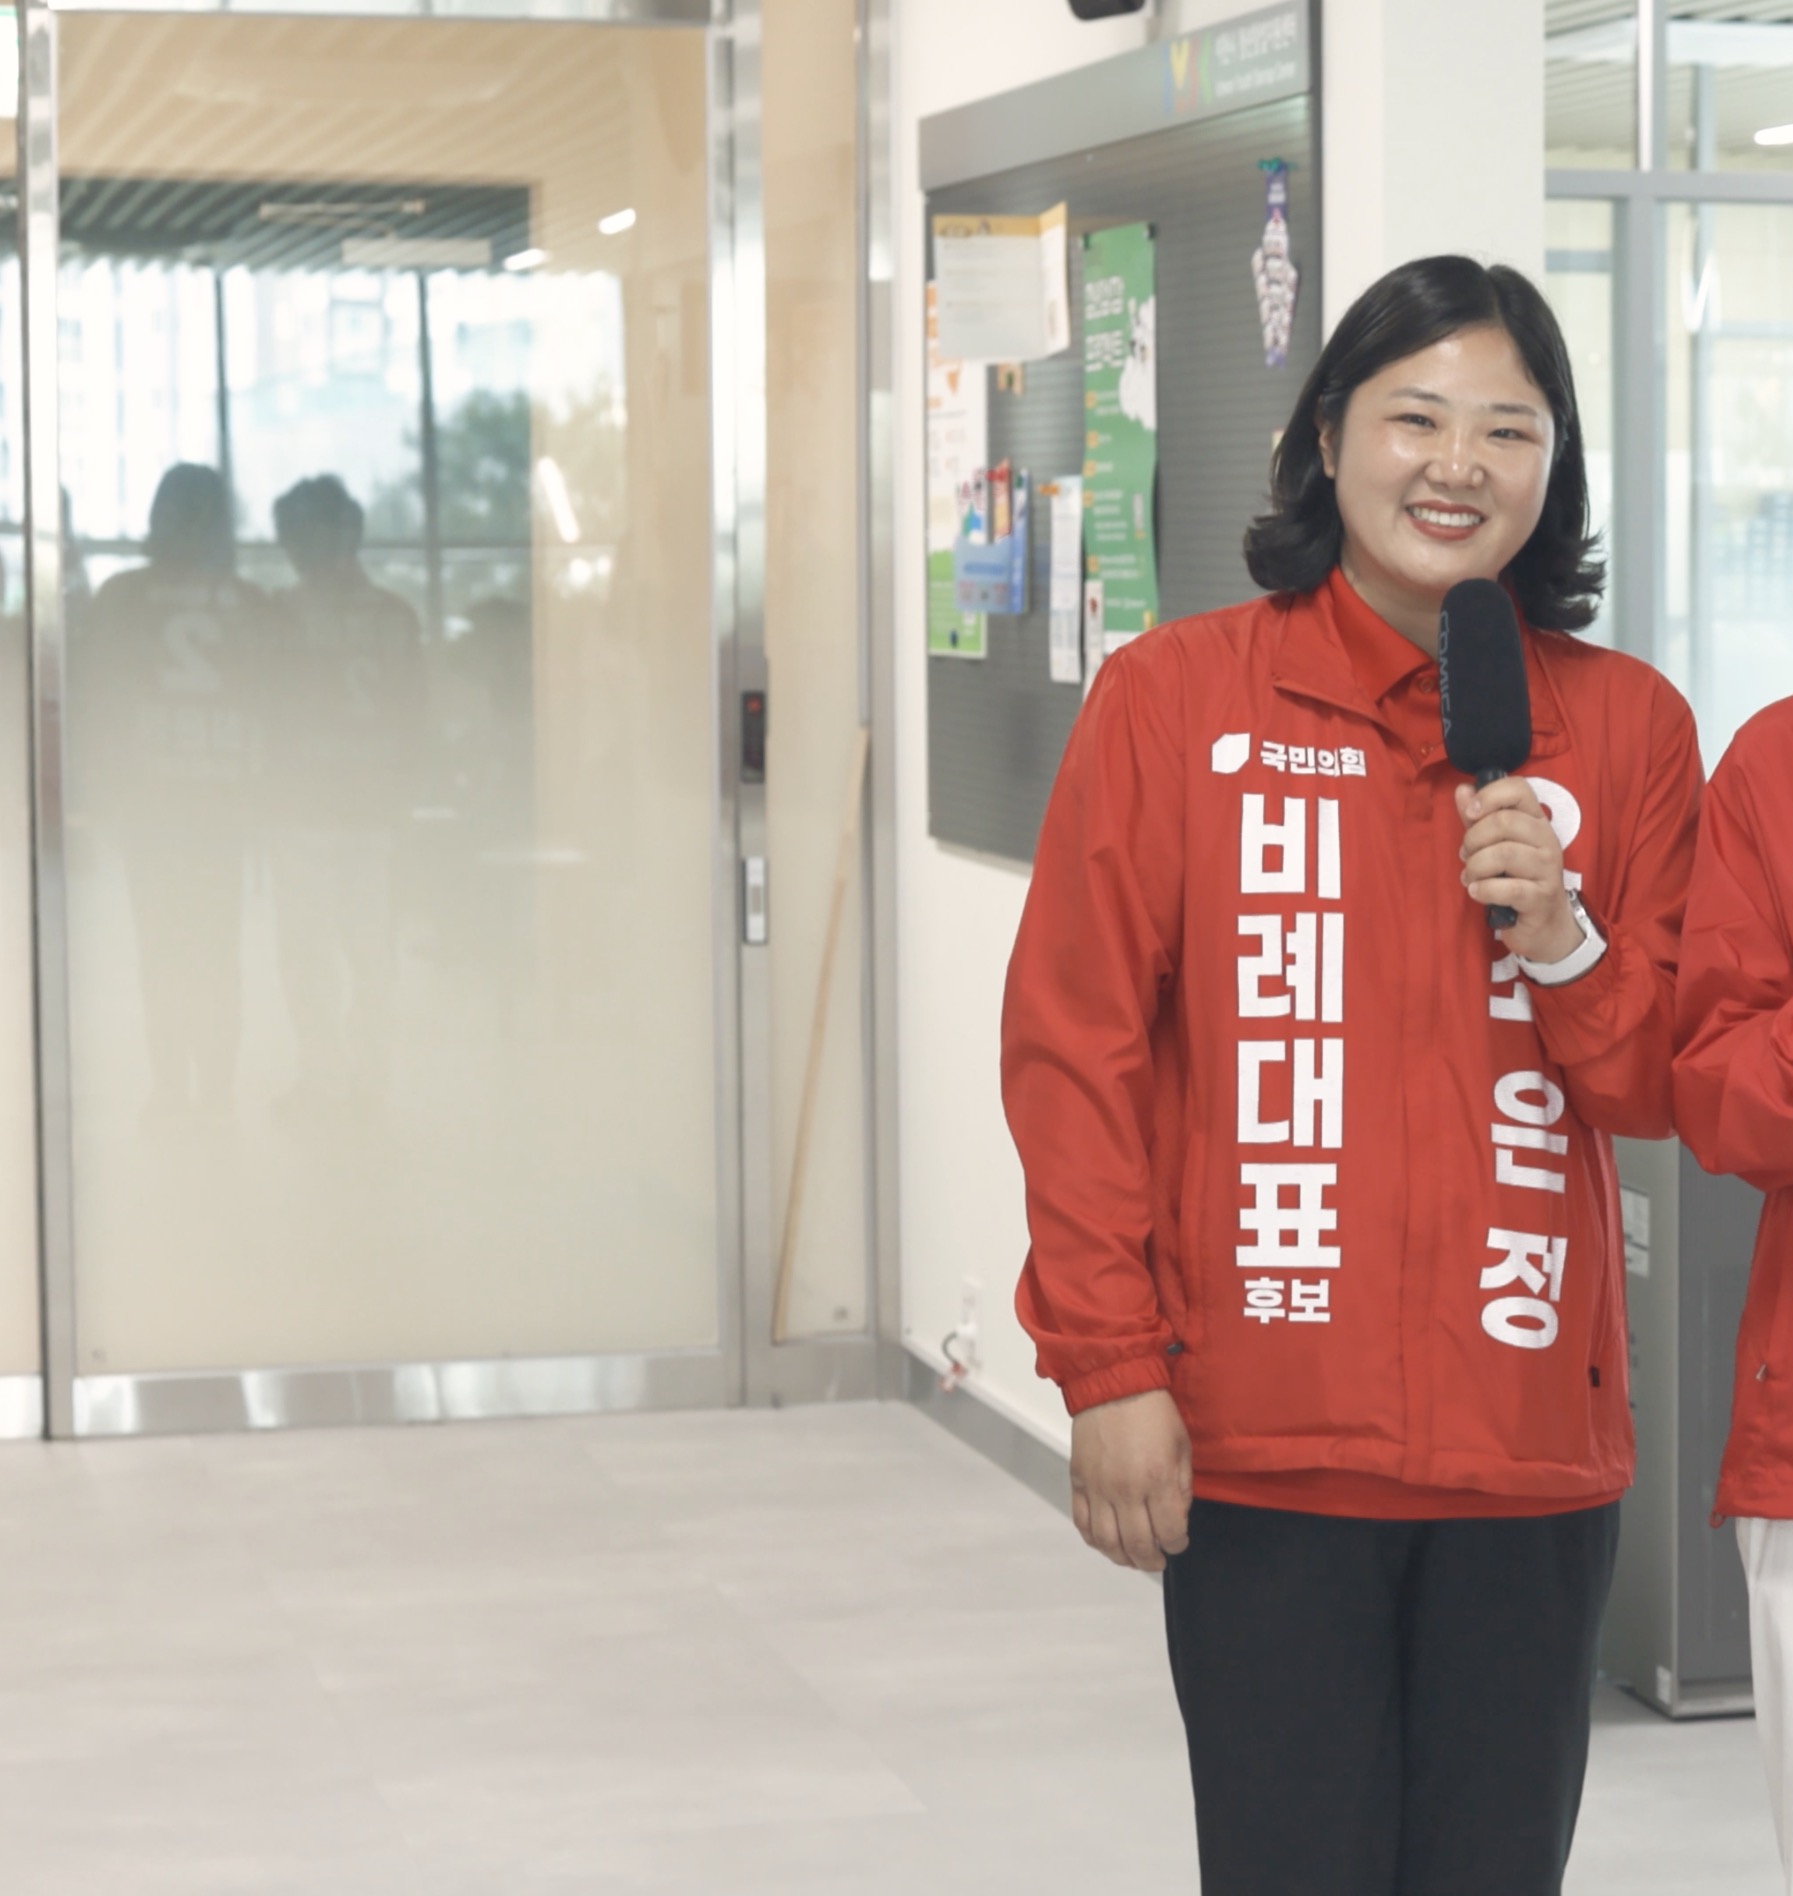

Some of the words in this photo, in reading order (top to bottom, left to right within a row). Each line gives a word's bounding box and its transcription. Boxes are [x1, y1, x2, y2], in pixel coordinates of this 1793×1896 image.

[1260, 740, 1366, 776] 국민의힘
[1236, 793, 1343, 1267] 비례대표
[1480, 777, 1583, 1350] 은정
[1243, 1276, 1331, 1323] 후보
